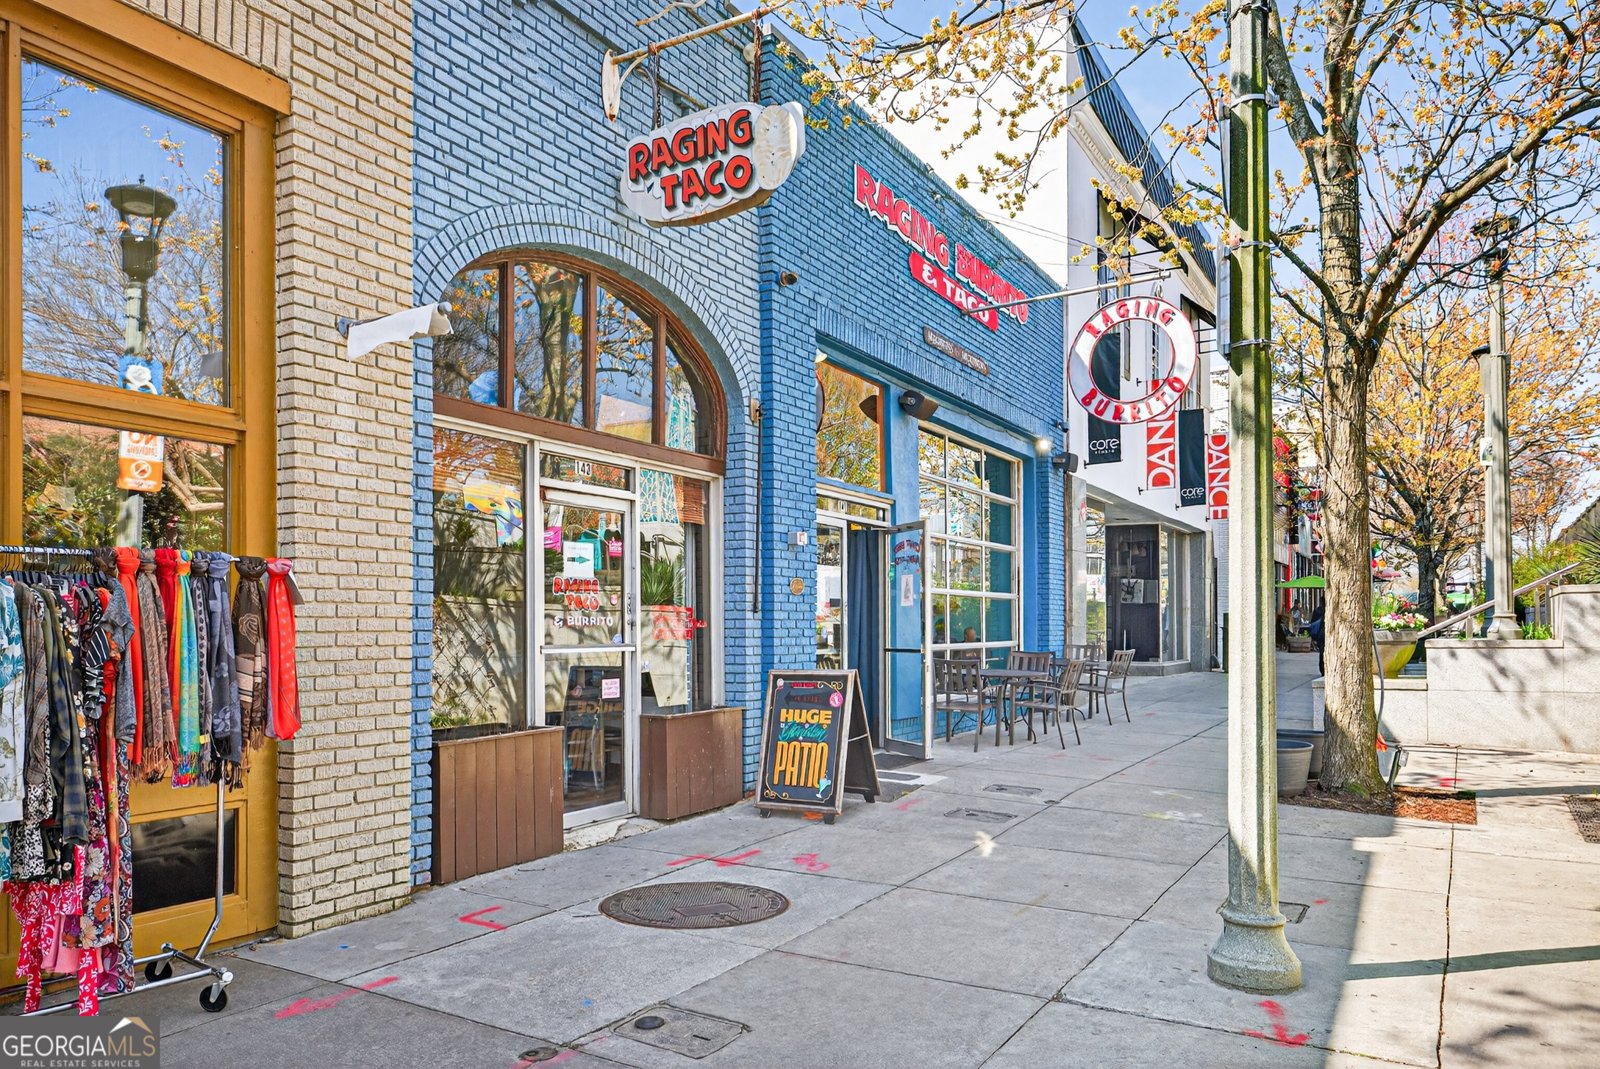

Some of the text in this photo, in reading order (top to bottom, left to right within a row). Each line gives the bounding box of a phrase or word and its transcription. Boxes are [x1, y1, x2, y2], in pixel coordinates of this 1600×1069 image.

[628, 109, 753, 182] RAGING
[660, 154, 753, 209] TACO
[854, 162, 950, 270] RAGING
[922, 263, 990, 323] & TACO
[1084, 300, 1176, 339] RAGING
[1081, 376, 1186, 421] BURRITO
[1089, 438, 1120, 451] core
[575, 461, 592, 476] 143
[1208, 434, 1230, 520] DANCE
[1181, 487, 1205, 497] core
[567, 616, 614, 627] BURRITO
[779, 708, 833, 724] HUGE
[773, 741, 829, 789] PATIO
